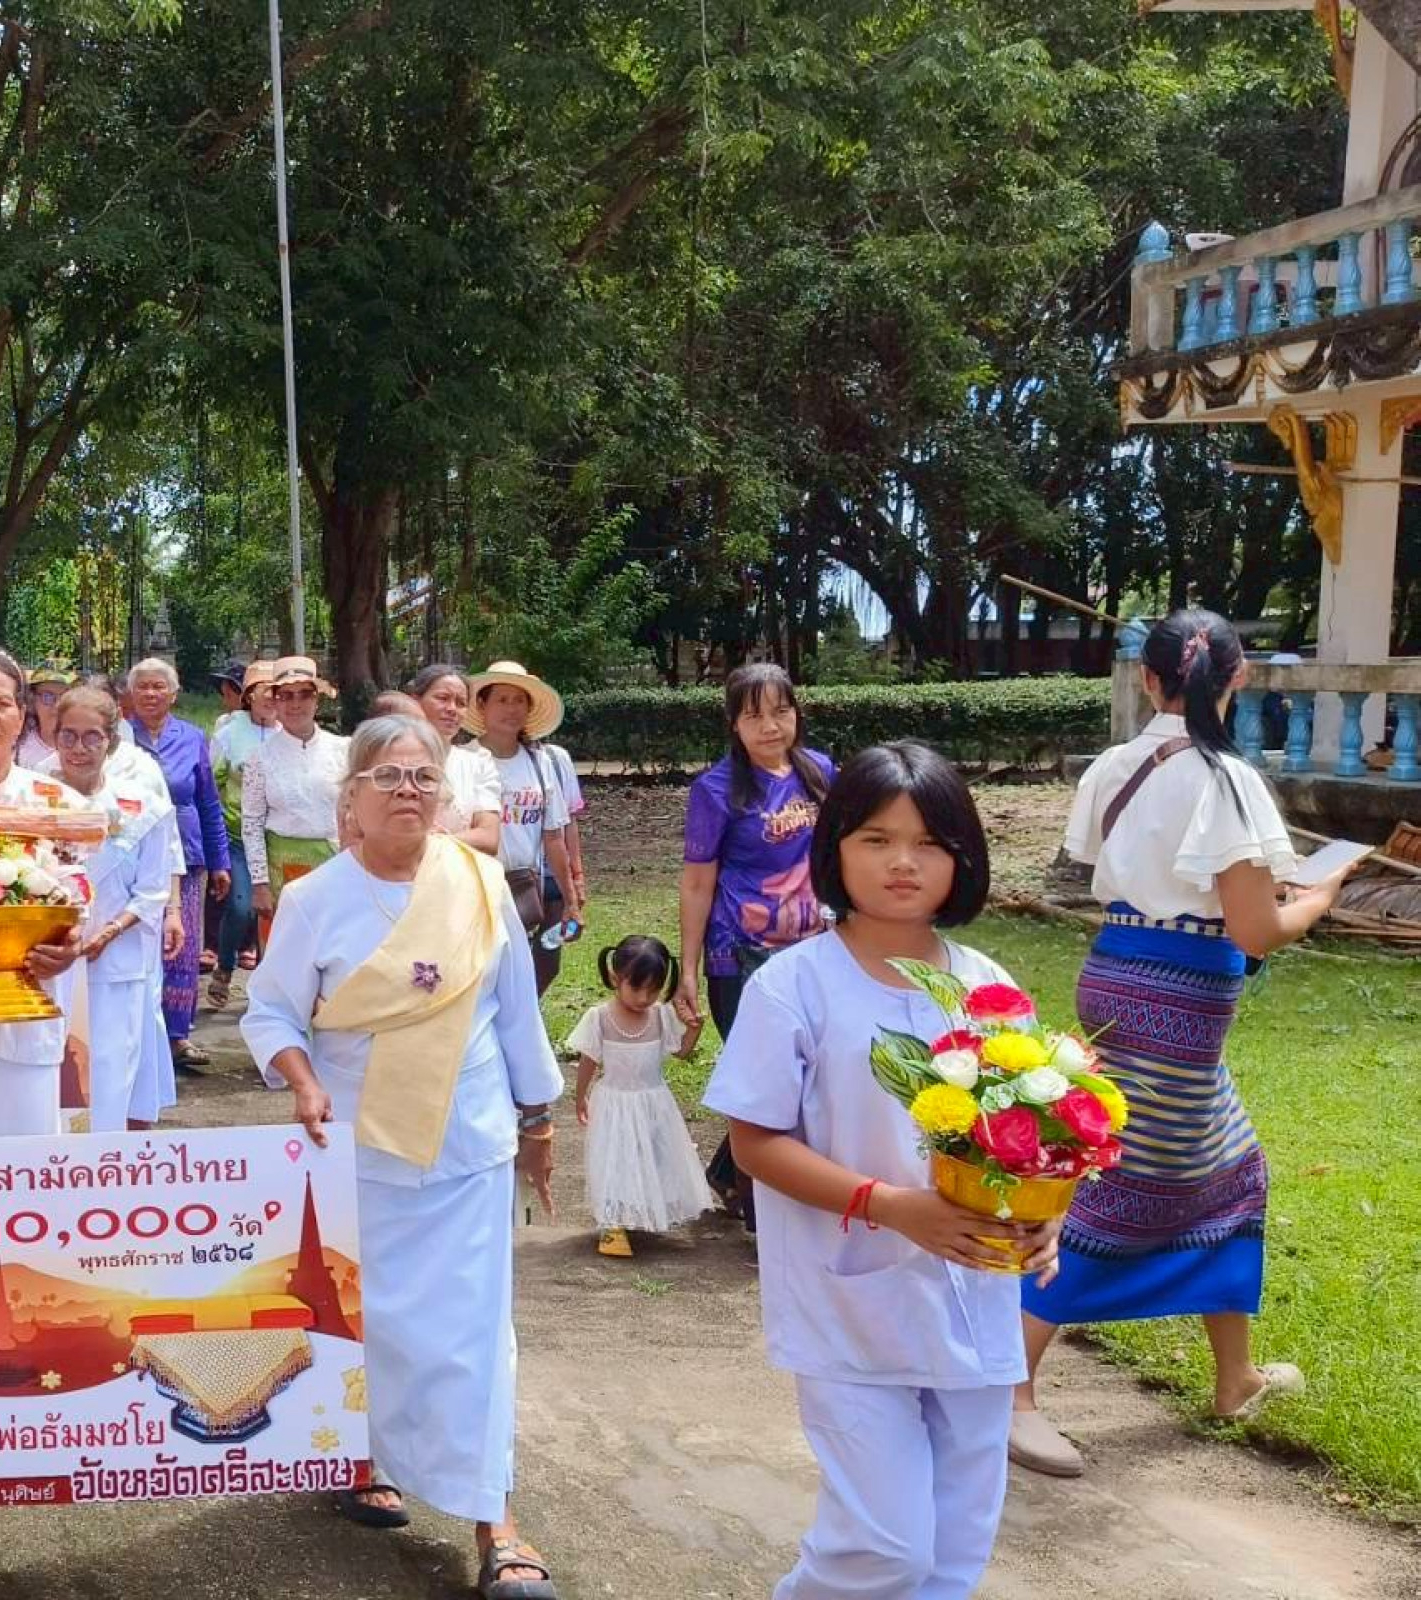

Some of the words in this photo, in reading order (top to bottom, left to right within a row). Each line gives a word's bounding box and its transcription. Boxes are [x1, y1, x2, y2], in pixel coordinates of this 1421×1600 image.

[228, 1213, 264, 1238] วัด
[77, 1249, 183, 1275] พุทธศักราช
[191, 1241, 254, 1265] ๒๕๖๘
[71, 1447, 355, 1500] จังหวัดศรีสะเกษ
